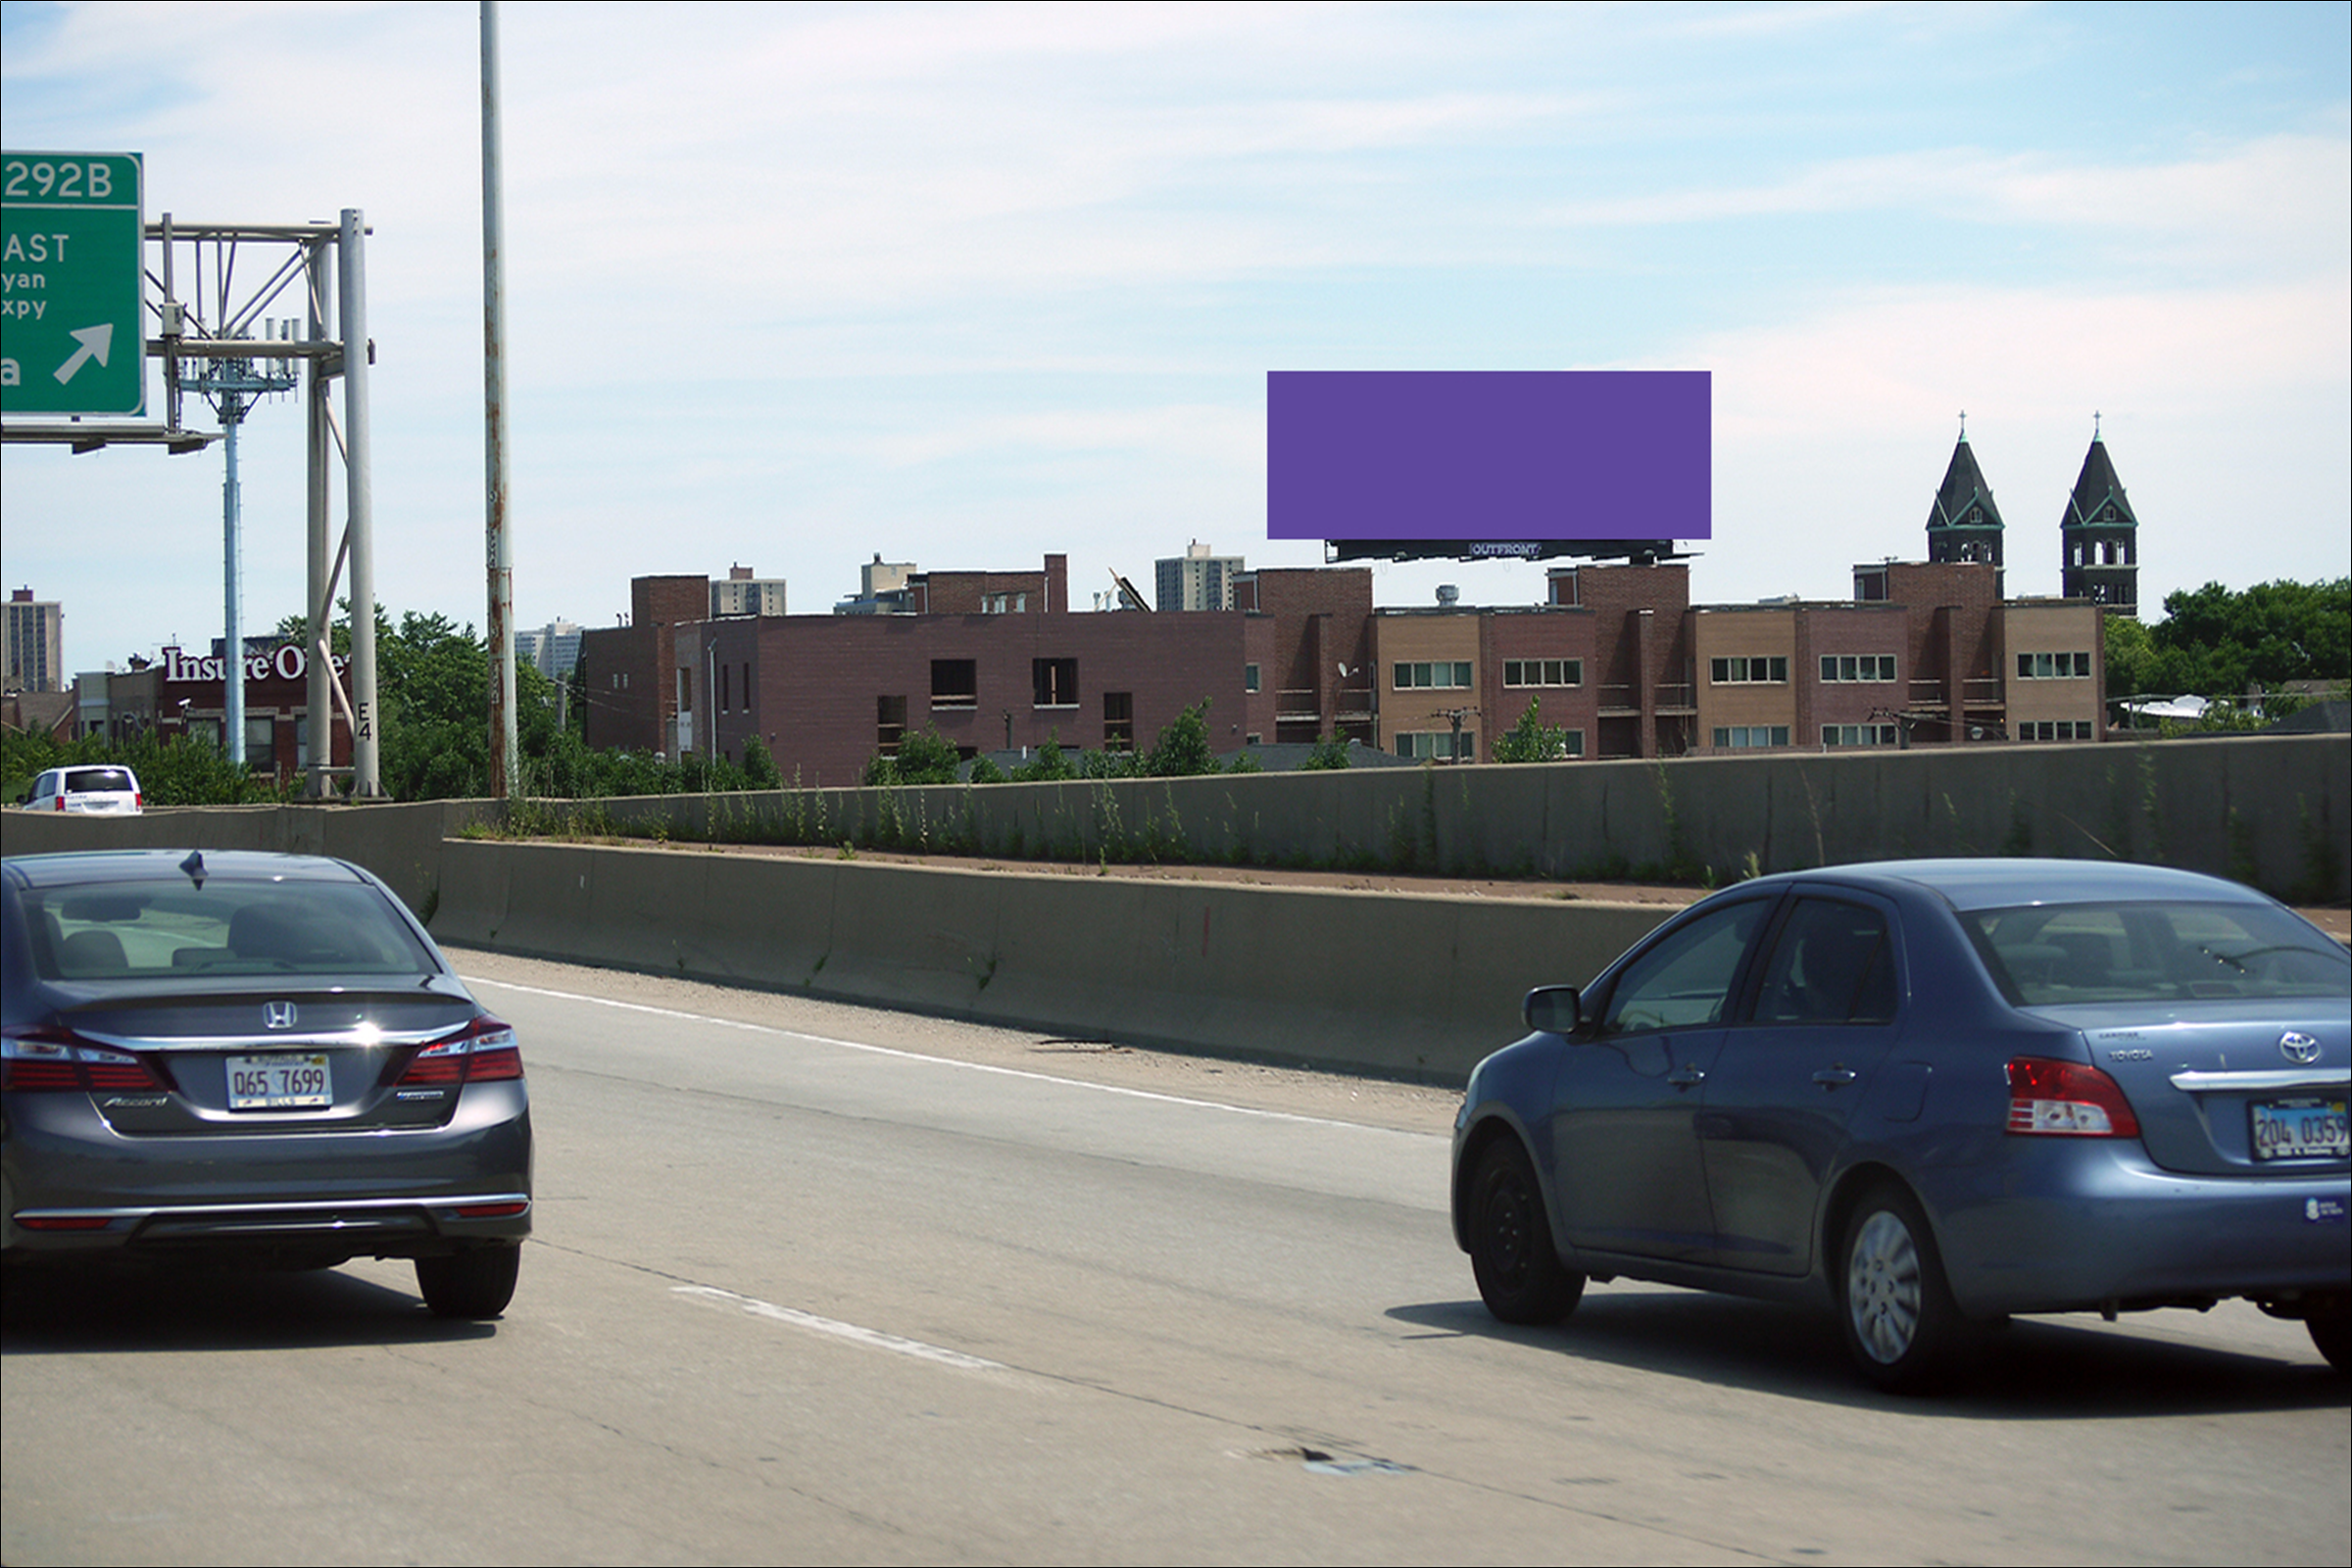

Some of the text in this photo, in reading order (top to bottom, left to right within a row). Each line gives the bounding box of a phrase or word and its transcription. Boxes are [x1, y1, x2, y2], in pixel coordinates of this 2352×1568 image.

[5, 161, 113, 198] 292B
[3, 233, 70, 263] AST
[1, 273, 46, 293] yan
[1, 300, 47, 320] xpy
[1472, 542, 1537, 556] OUTFRONT
[275, 644, 345, 680] Oe
[2109, 1048, 2153, 1061] TOYOTA
[278, 1067, 325, 1096] 7699
[2256, 1114, 2348, 1148] 204 0359
